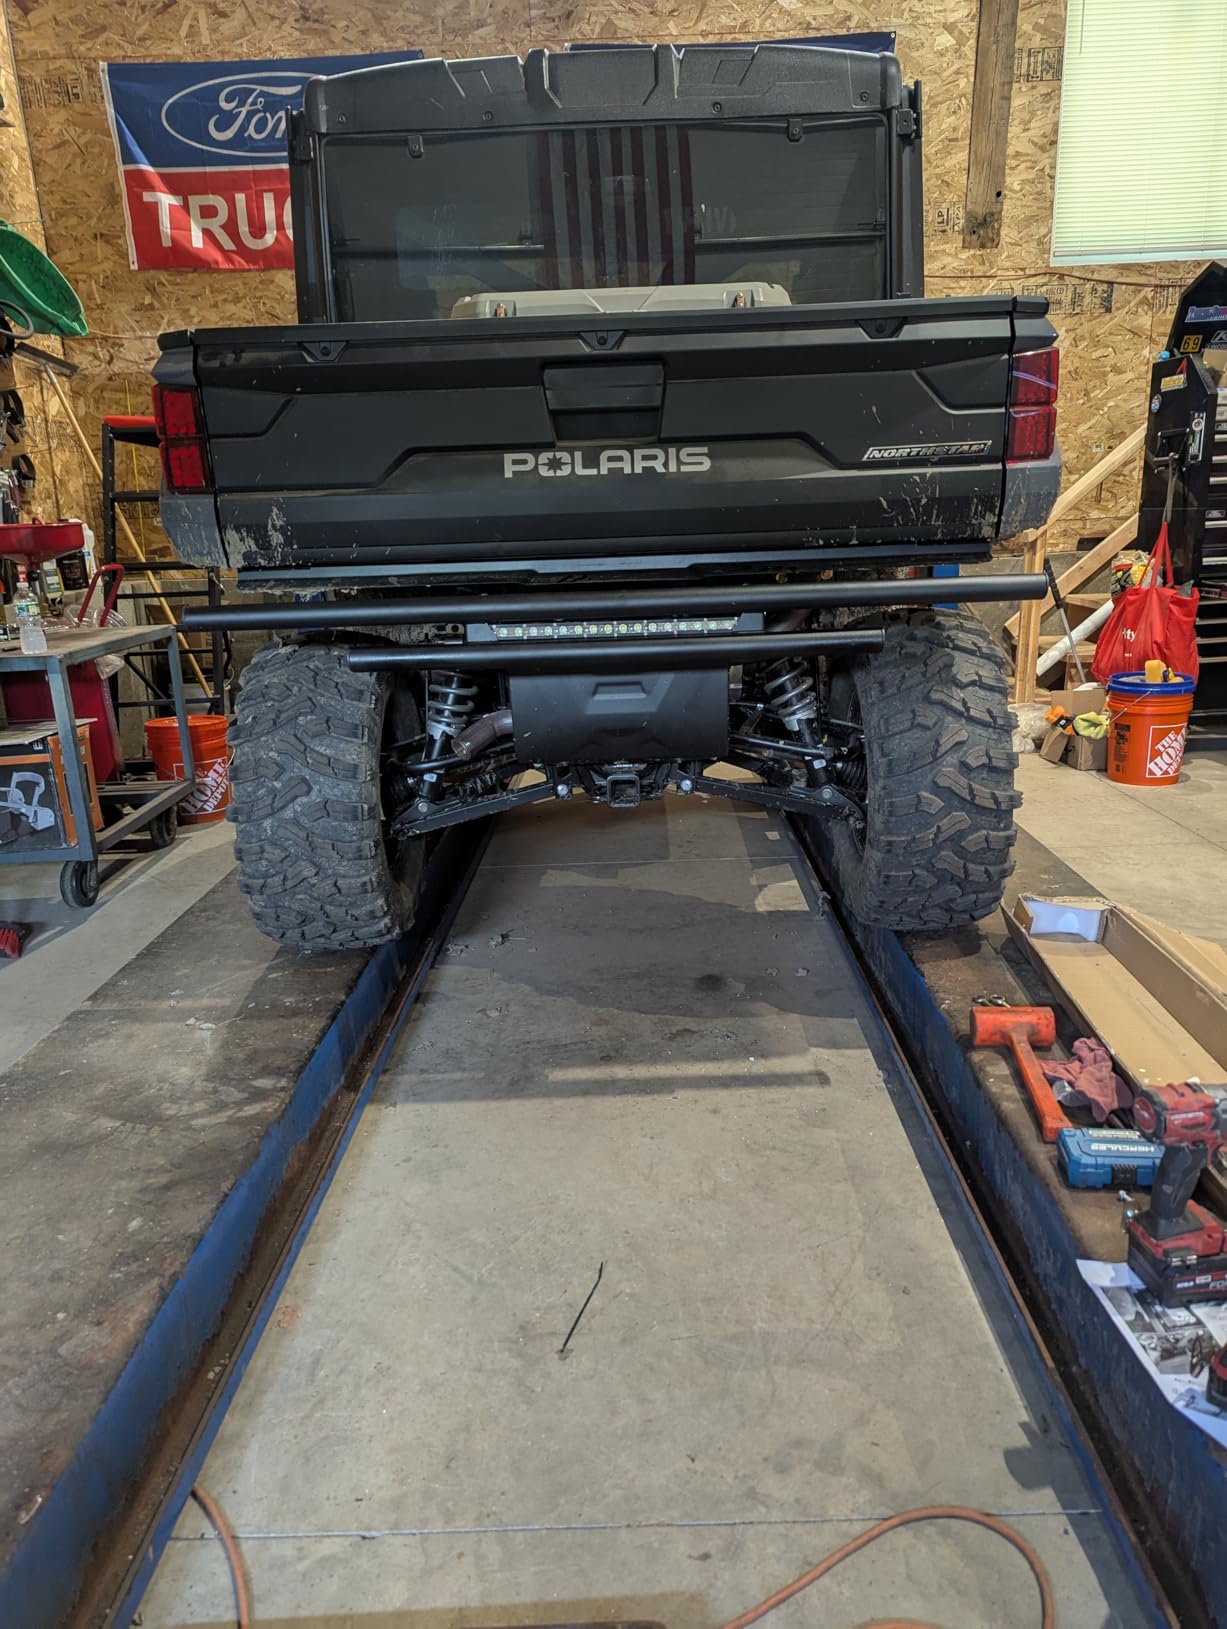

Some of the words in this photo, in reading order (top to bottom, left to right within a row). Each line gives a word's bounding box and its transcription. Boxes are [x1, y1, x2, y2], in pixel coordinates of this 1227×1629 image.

[143, 191, 293, 250] TRU
[1182, 336, 1200, 350] 69
[868, 443, 984, 459] NORTHSTAR
[504, 447, 711, 478] POLARIS
[1090, 1143, 1155, 1153] HERCULES
